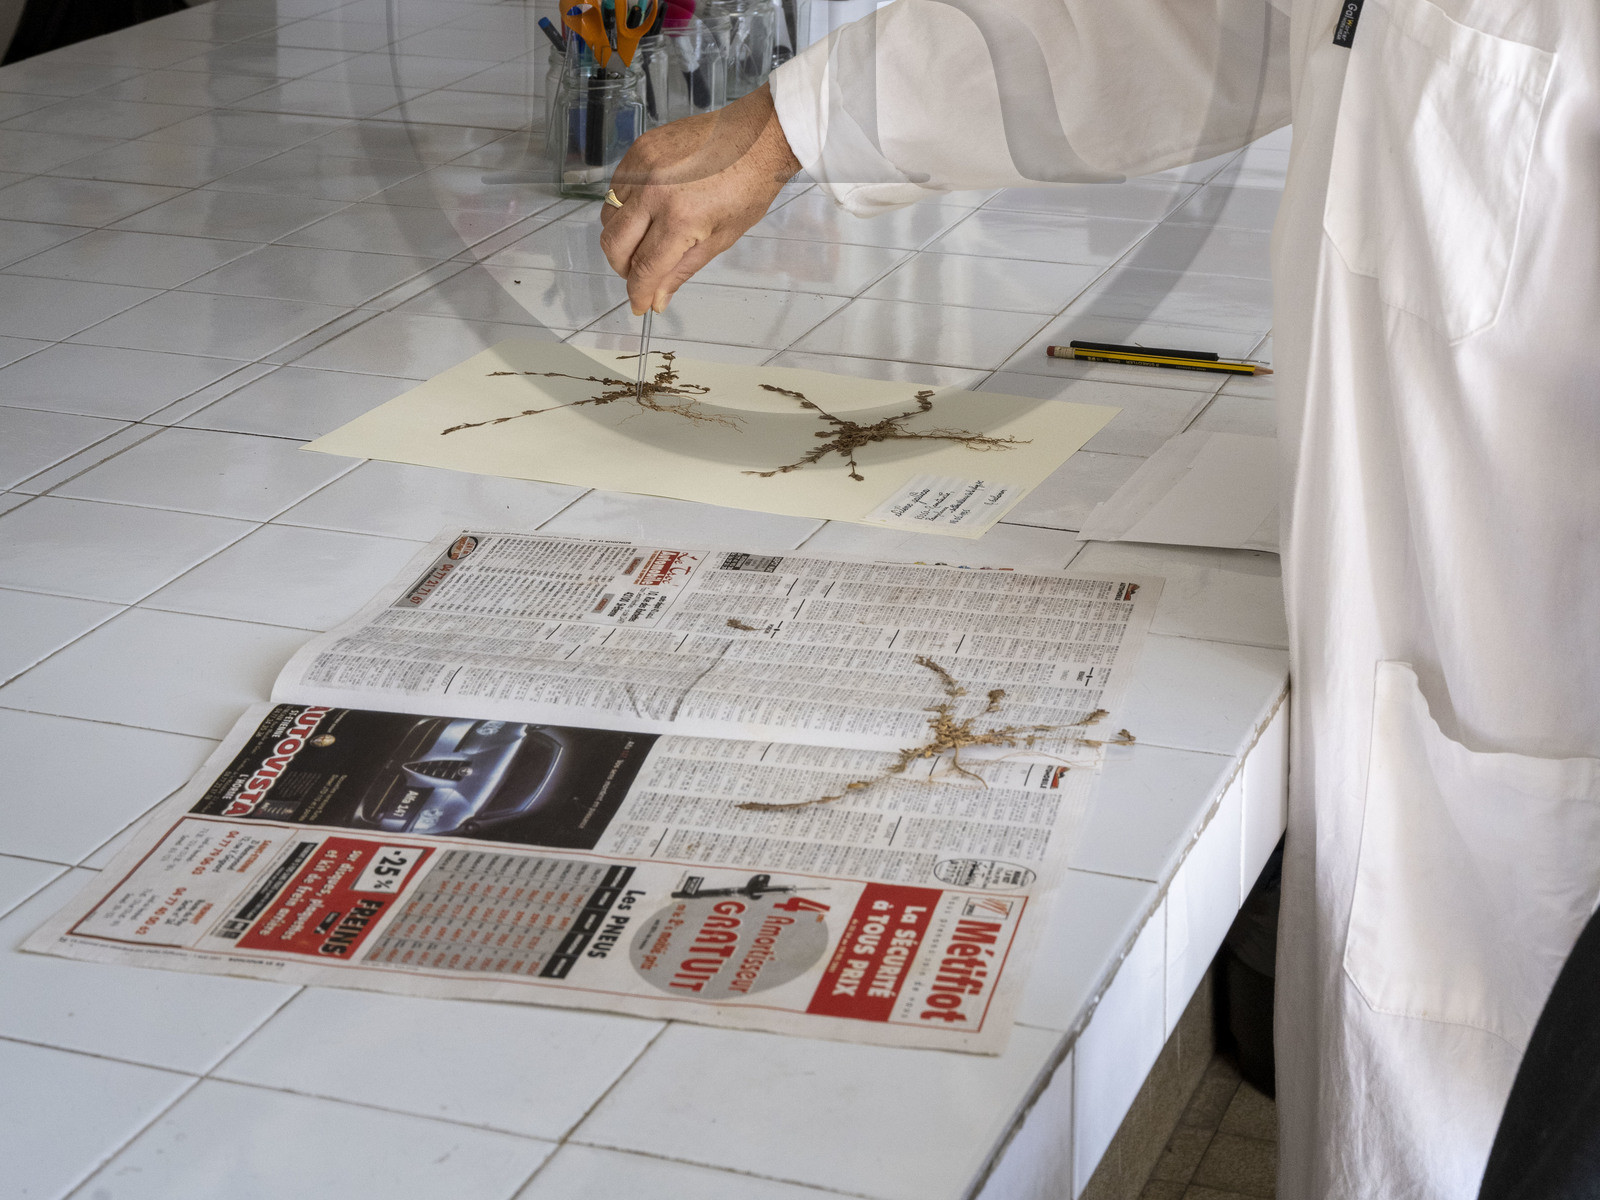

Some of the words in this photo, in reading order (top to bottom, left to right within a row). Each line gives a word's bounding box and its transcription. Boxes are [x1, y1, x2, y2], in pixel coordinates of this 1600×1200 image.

[439, 563, 454, 571] 04
[432, 571, 446, 579] 77
[424, 579, 438, 587] 21
[416, 587, 431, 595] 71
[409, 595, 422, 604] 67
[221, 706, 338, 818] AUTOVISTA
[401, 790, 418, 803] Alfa
[393, 804, 408, 817] 147
[226, 830, 239, 838] 04
[218, 839, 231, 847] 77
[324, 849, 337, 858] et
[346, 849, 362, 861] sur
[314, 859, 334, 871] kit
[374, 850, 406, 876] -25
[303, 873, 321, 883] de
[316, 862, 353, 896] disques,
[373, 879, 393, 889] %
[164, 896, 178, 906] 77
[285, 885, 312, 906] frein
[617, 889, 645, 910] Les
[872, 900, 893, 910] à
[259, 907, 289, 935] arrière
[281, 898, 323, 939] plaquettes
[900, 905, 926, 923] La
[318, 899, 382, 954] FREINS
[853, 914, 889, 953] TOUS
[587, 915, 629, 957] PNEUS
[671, 901, 744, 990] GRATUIT
[730, 915, 793, 992] Amortisseur
[868, 929, 916, 997] SÉCURITÉ
[922, 920, 999, 1021] Métifiot
[833, 959, 868, 995] PRIX
